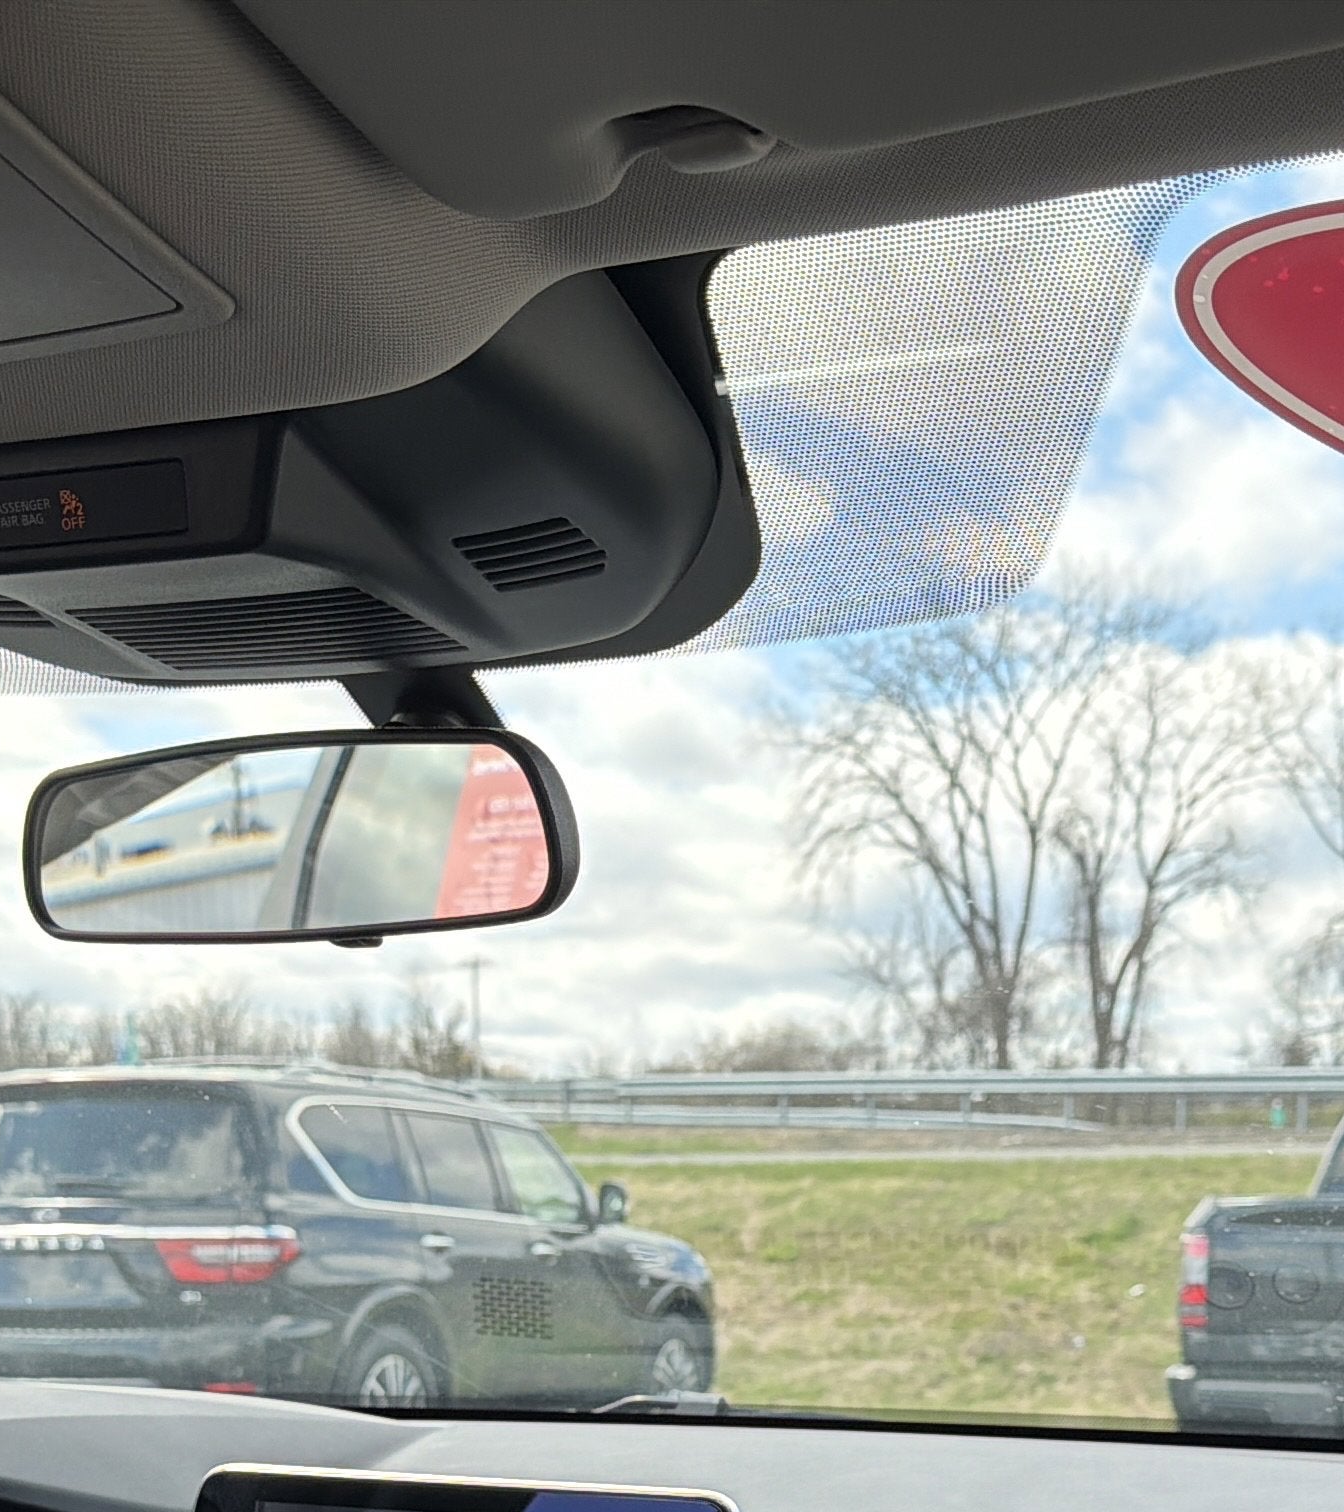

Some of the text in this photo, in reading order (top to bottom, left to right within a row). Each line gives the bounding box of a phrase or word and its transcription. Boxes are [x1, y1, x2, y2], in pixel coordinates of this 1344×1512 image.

[0, 514, 44, 528] AIR BAG
[61, 516, 86, 531] OFF
